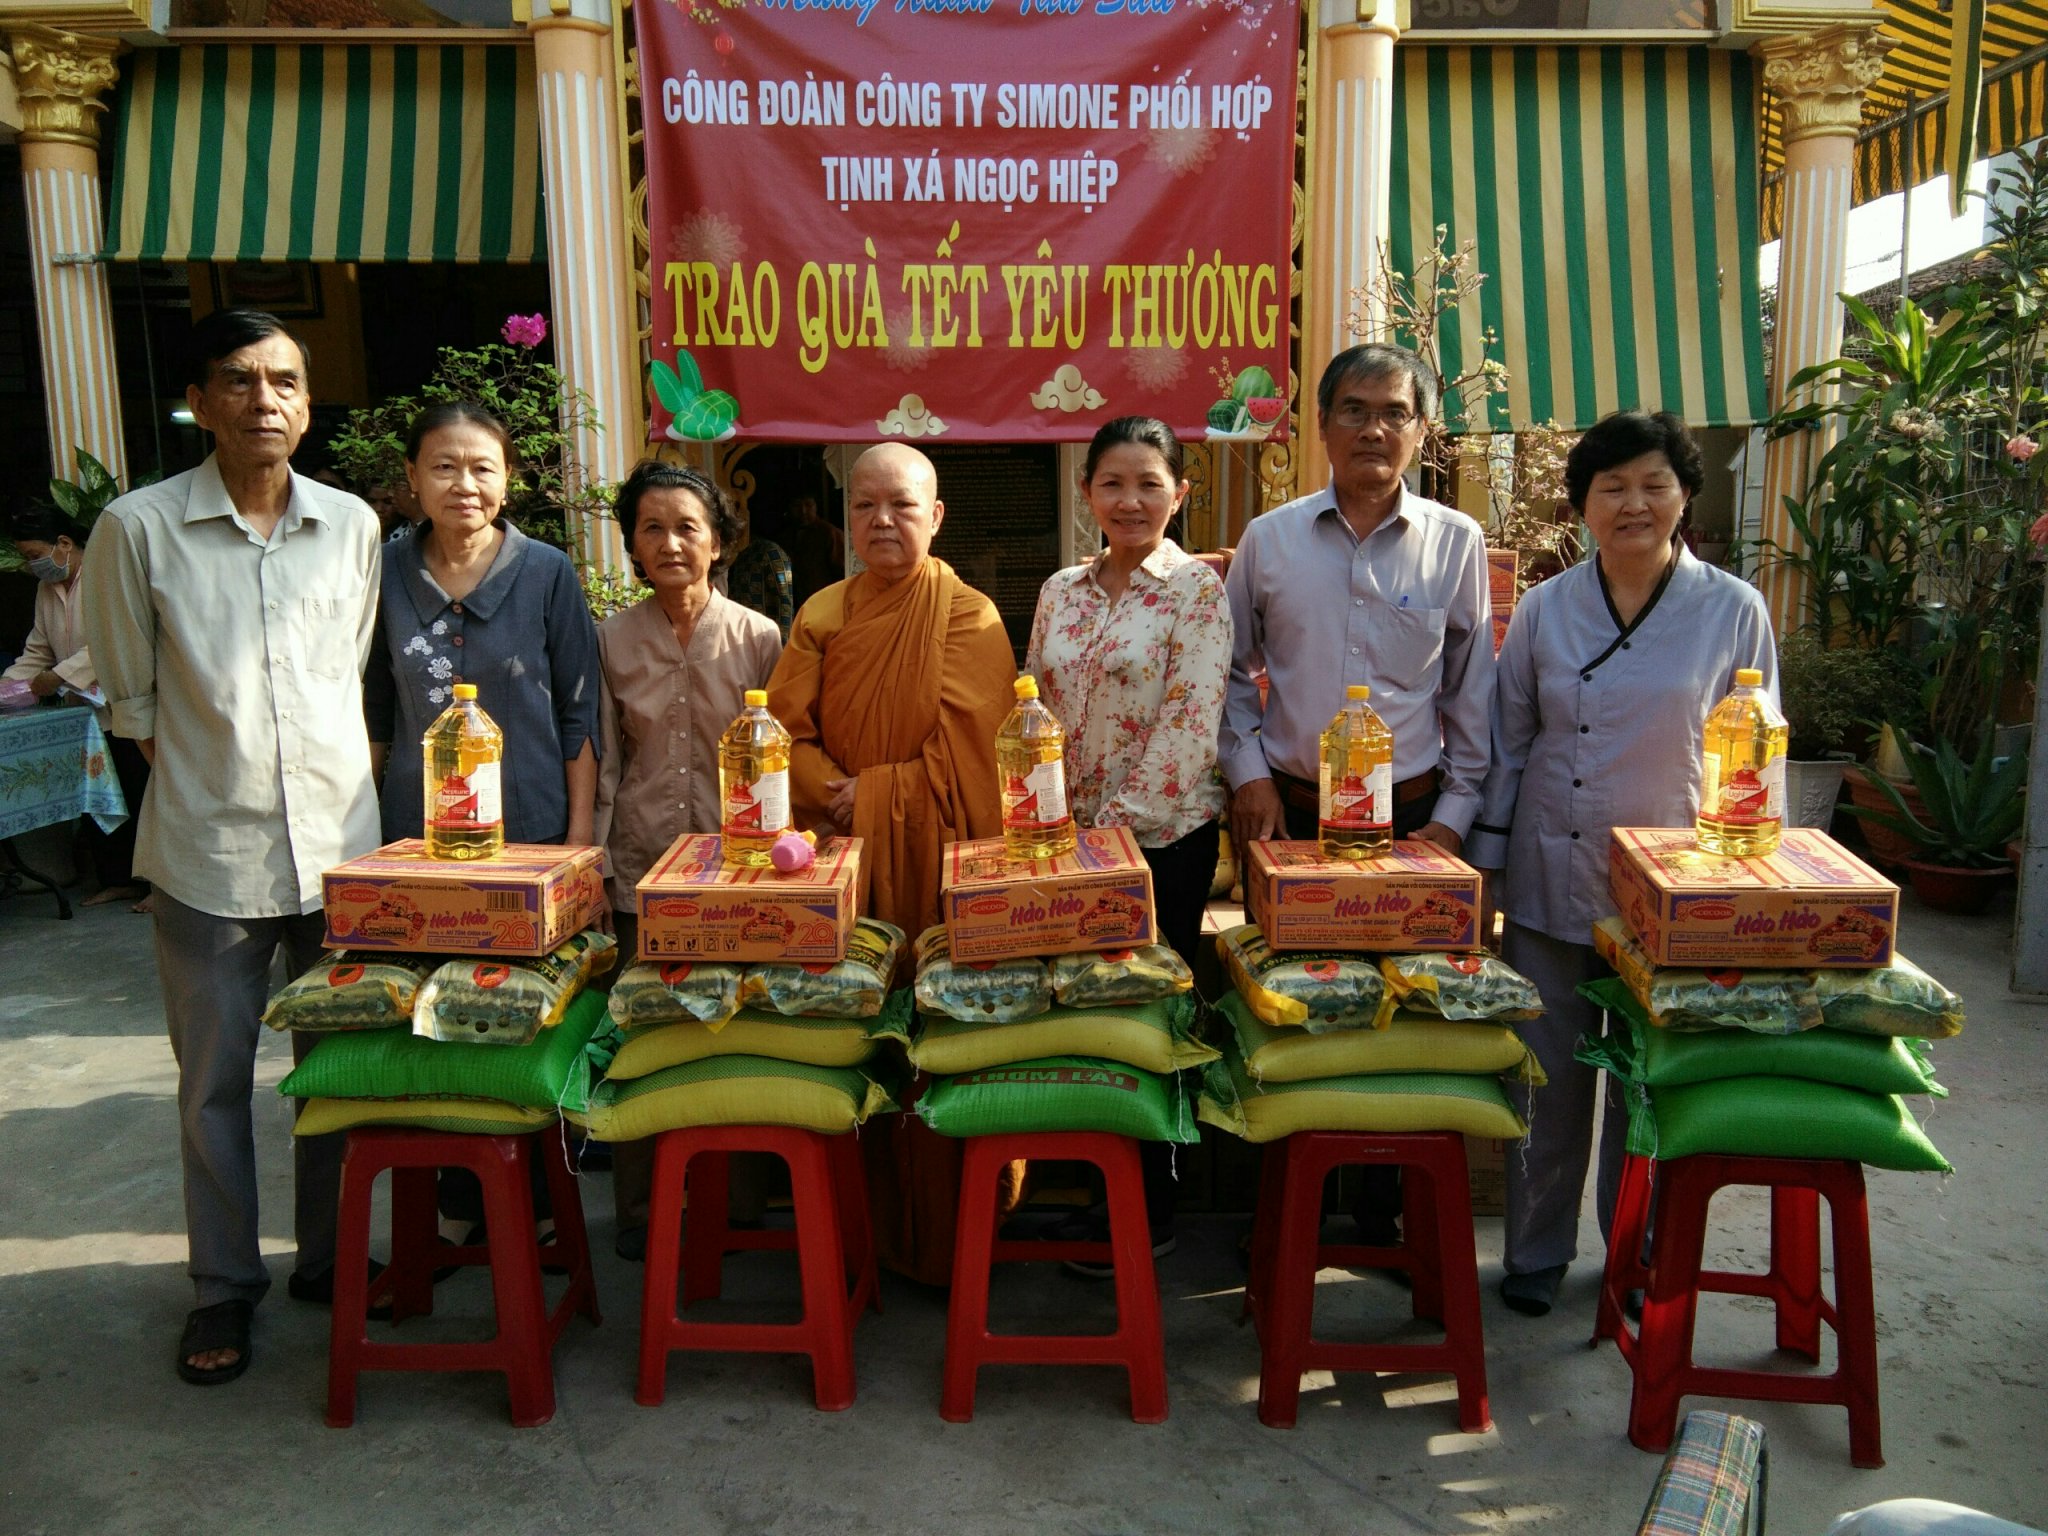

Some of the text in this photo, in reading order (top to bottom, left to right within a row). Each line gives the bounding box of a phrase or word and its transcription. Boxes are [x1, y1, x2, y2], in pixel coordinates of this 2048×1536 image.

[662, 69, 1273, 139] CÔNG ĐOÀN CÔNG TY SIMONE PHỐI HỢP
[822, 148, 1118, 213] TỊNH XÁ NGỌC HIỆP
[664, 219, 1280, 373] TRAO QUÀ TẾT YÊU THƯƠNG
[442, 787, 469, 795] Neptune
[1340, 788, 1366, 796] Neptune
[1730, 782, 1761, 790] Neptune
[701, 902, 756, 922] Hảo Hảo
[1010, 892, 1085, 927] Hảo Hảo
[1335, 891, 1412, 917] Hảo Hảo
[429, 908, 488, 928] Hảo Hảo
[1734, 906, 1822, 935] Hảo Hảo
[799, 922, 835, 945] 20
